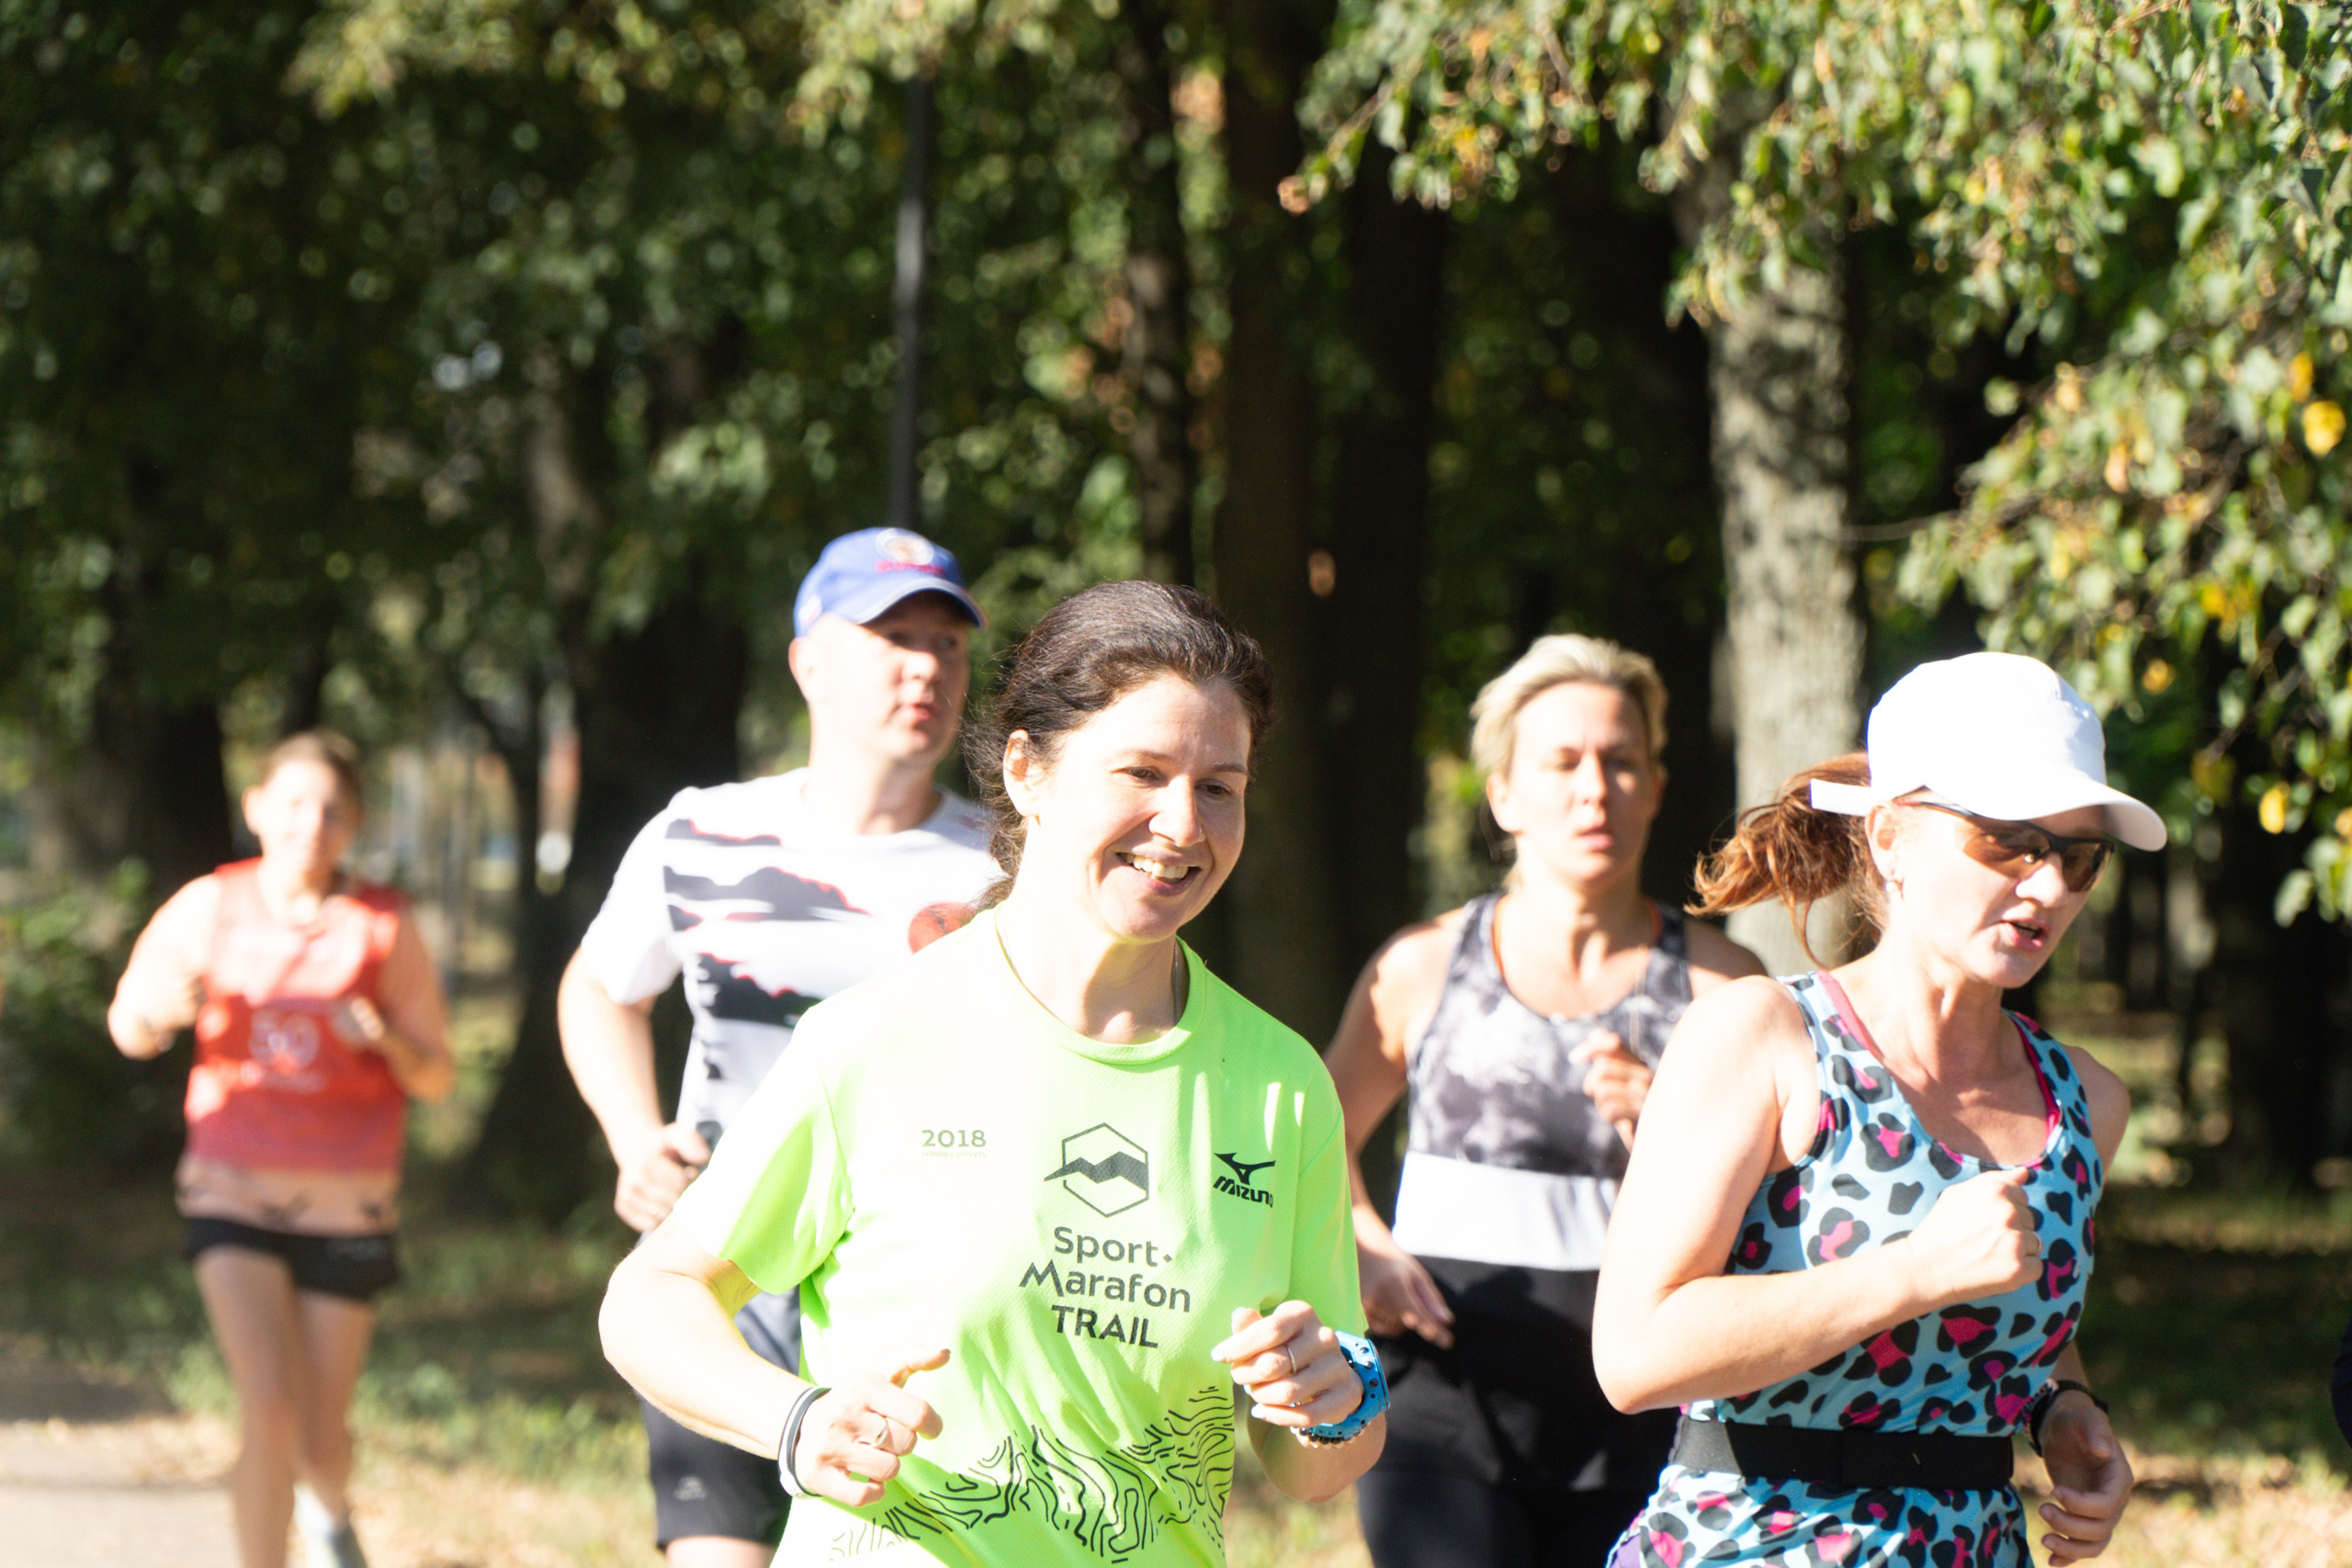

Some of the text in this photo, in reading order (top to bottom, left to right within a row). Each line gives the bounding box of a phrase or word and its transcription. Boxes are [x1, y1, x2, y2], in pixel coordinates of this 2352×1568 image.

[922, 1129, 987, 1148] 2018
[1019, 1258, 1191, 1313] Marafon
[1051, 1304, 1159, 1348] TRAIL
